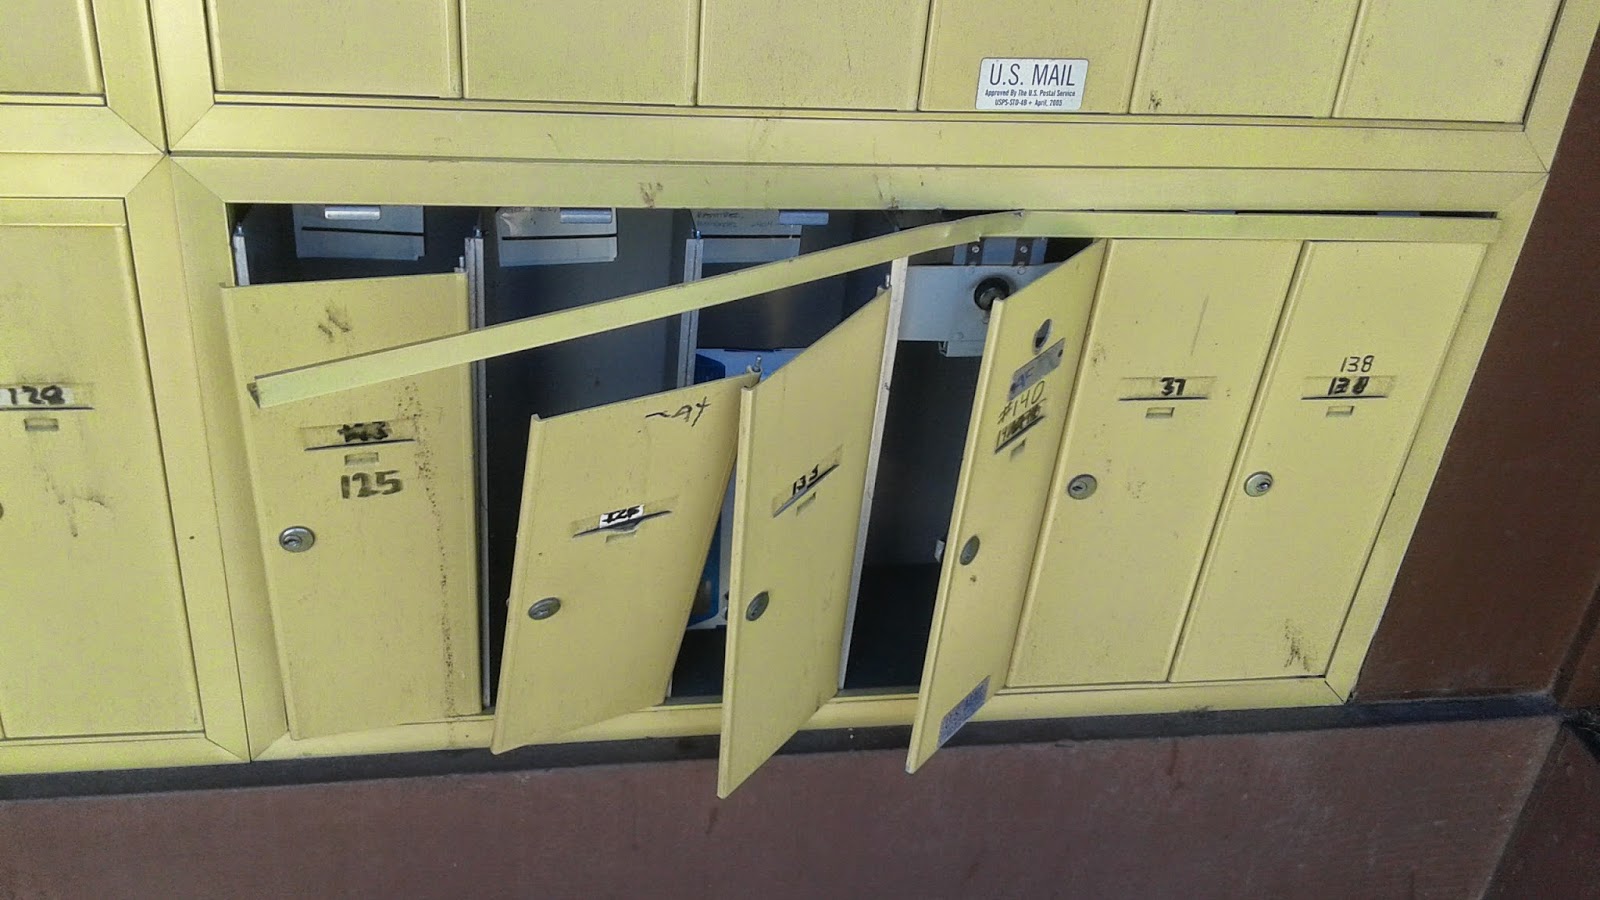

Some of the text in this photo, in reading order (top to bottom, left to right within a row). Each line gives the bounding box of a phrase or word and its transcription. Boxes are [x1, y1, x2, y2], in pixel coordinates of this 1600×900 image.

[989, 63, 1076, 87] U.S. MAIL
[985, 89, 1009, 97] Approved
[1010, 89, 1017, 97] By
[1340, 355, 1375, 373] 138
[1160, 376, 1187, 396] 37
[340, 469, 404, 499] 125
